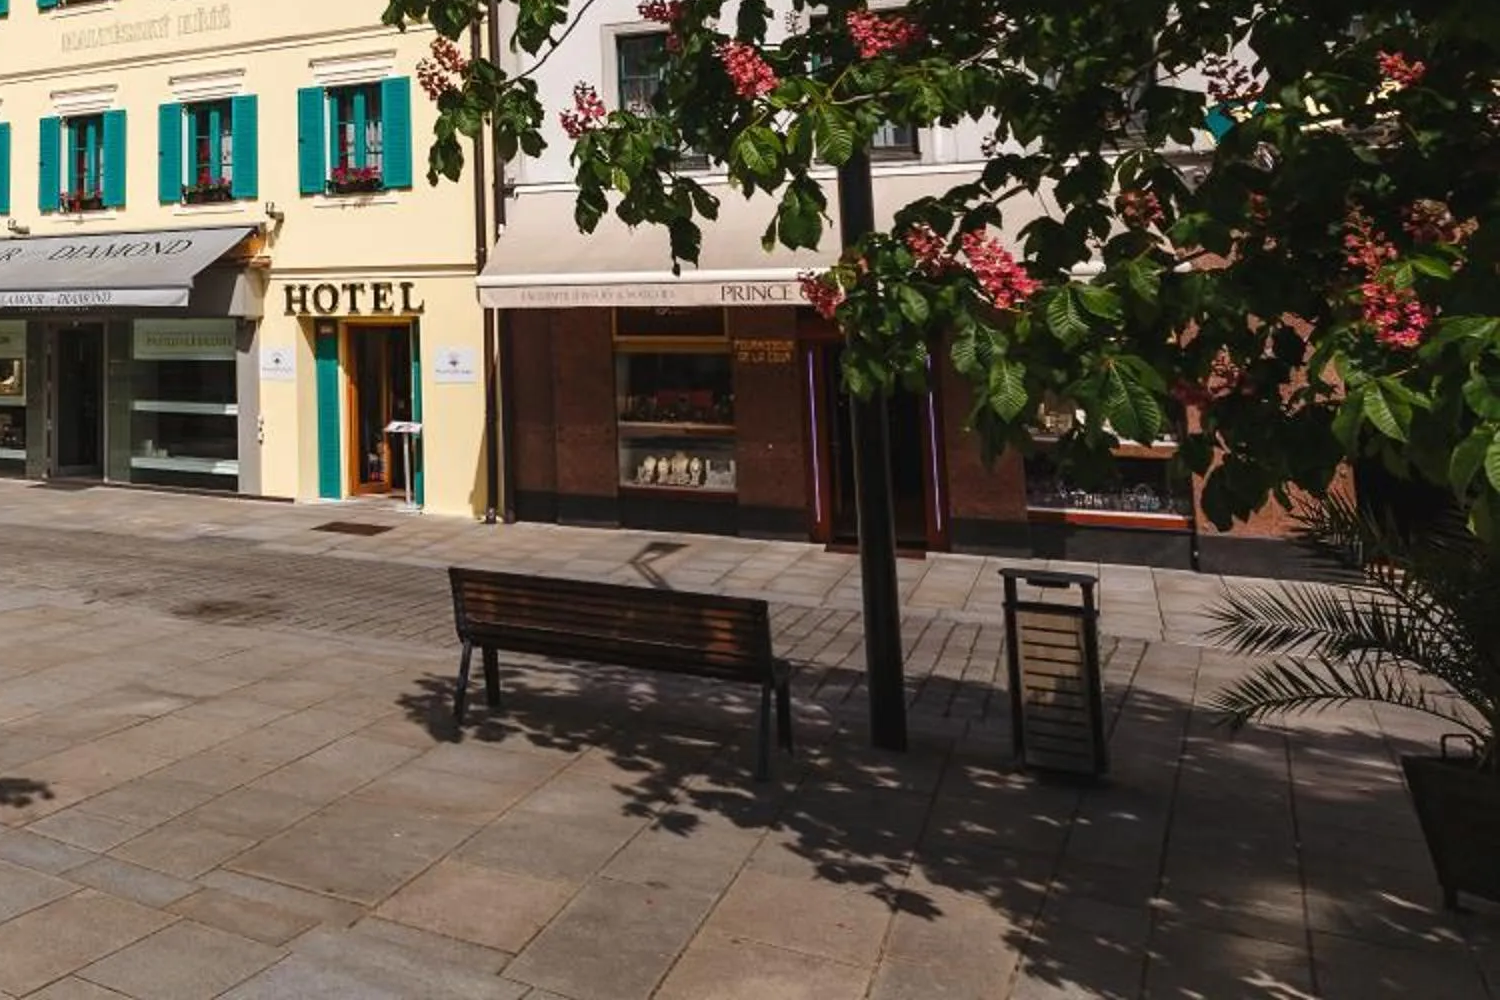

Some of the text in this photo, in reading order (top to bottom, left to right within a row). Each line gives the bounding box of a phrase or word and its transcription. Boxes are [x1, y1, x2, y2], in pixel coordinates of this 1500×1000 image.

[48, 238, 193, 262] DIAMOND
[56, 291, 112, 305] DIAMOND
[283, 282, 425, 316] HOTEL
[721, 284, 793, 301] PRINCE
